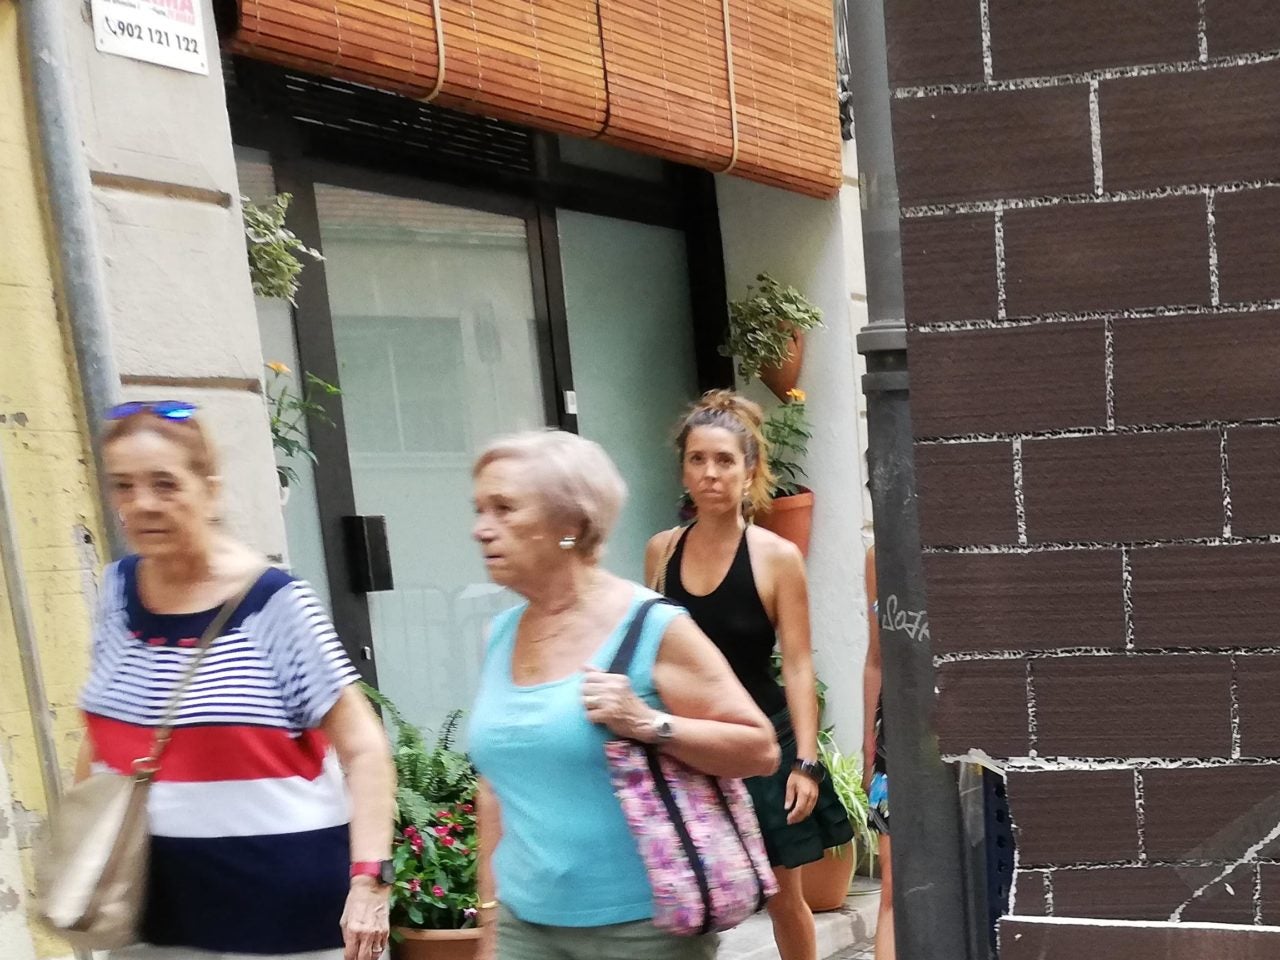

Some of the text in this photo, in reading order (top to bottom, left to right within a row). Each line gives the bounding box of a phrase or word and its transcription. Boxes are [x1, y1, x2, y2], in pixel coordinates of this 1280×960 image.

[117, 20, 199, 54] 902 121 122
